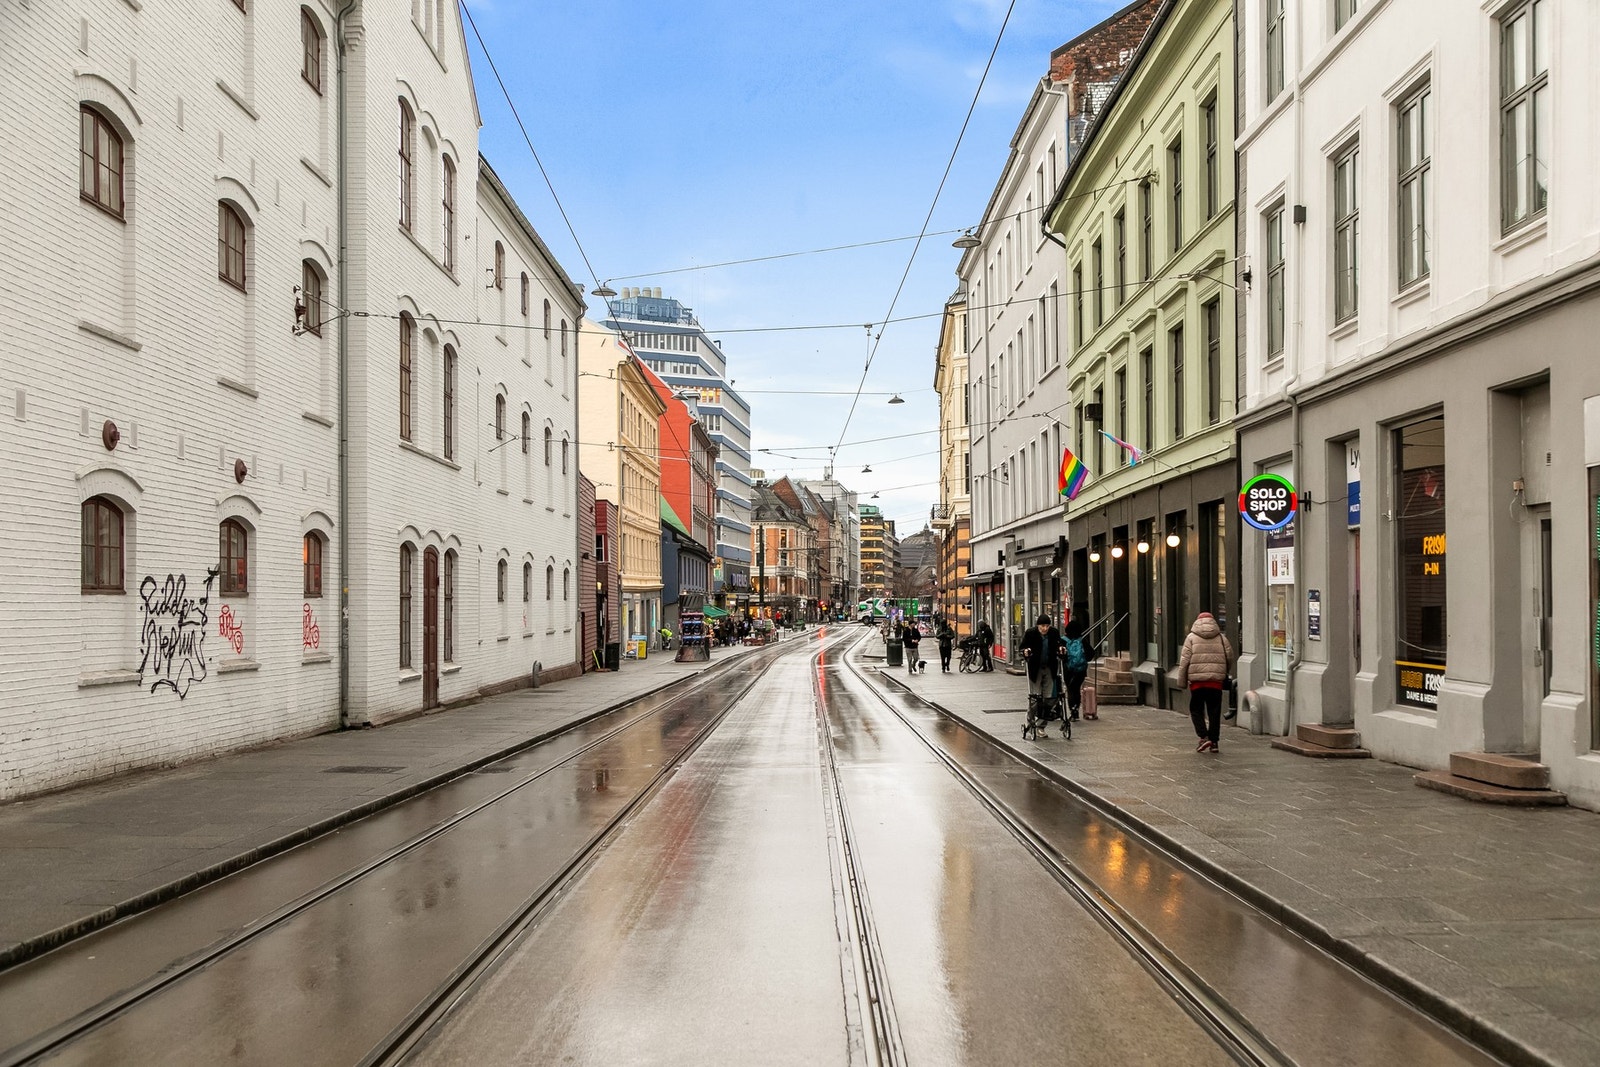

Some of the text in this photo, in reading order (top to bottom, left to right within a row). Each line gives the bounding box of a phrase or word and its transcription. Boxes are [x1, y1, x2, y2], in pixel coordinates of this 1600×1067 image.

[1350, 447, 1360, 468] Ly
[1250, 488, 1287, 499] SOLO
[1250, 500, 1287, 511] SHOP
